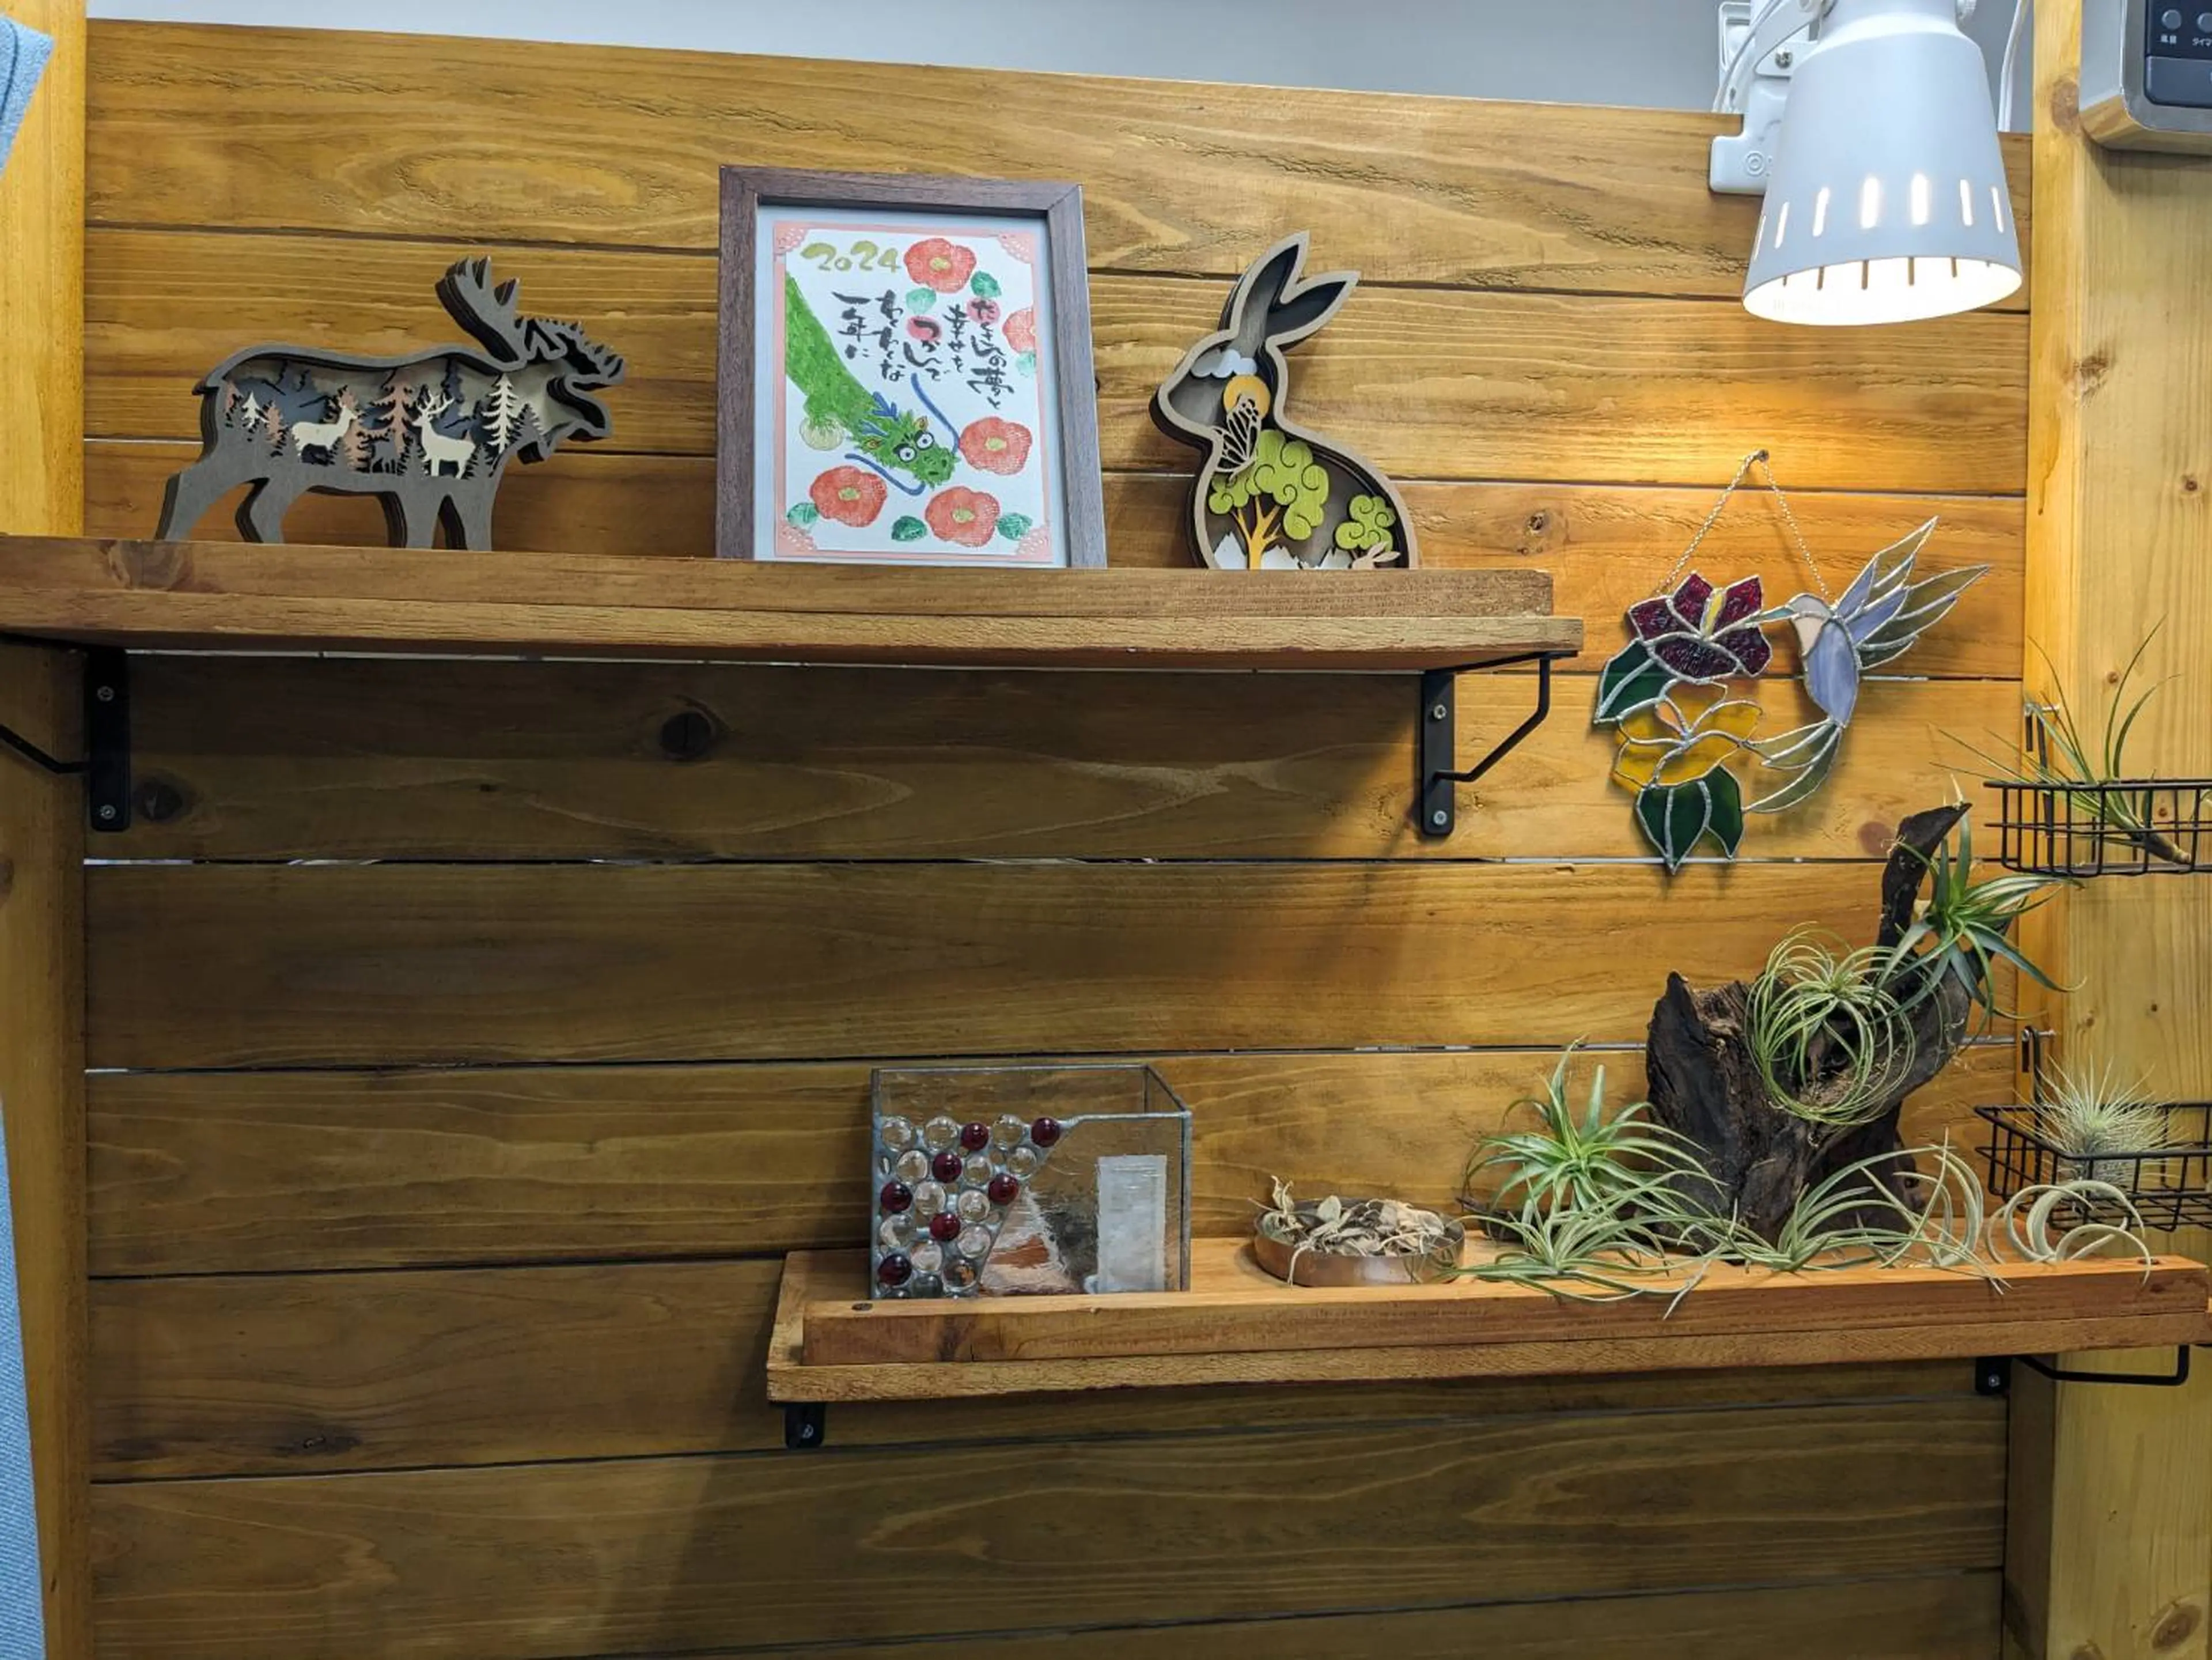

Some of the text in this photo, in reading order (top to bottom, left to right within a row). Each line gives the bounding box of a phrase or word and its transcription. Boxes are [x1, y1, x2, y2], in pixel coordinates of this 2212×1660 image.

[801, 240, 902, 273] 2024
[831, 291, 872, 360] 一年に
[872, 289, 905, 382] わくわくな
[903, 318, 950, 381] つかんで
[943, 304, 970, 373] 幸せを
[966, 300, 1015, 410] たくさんの夢と
